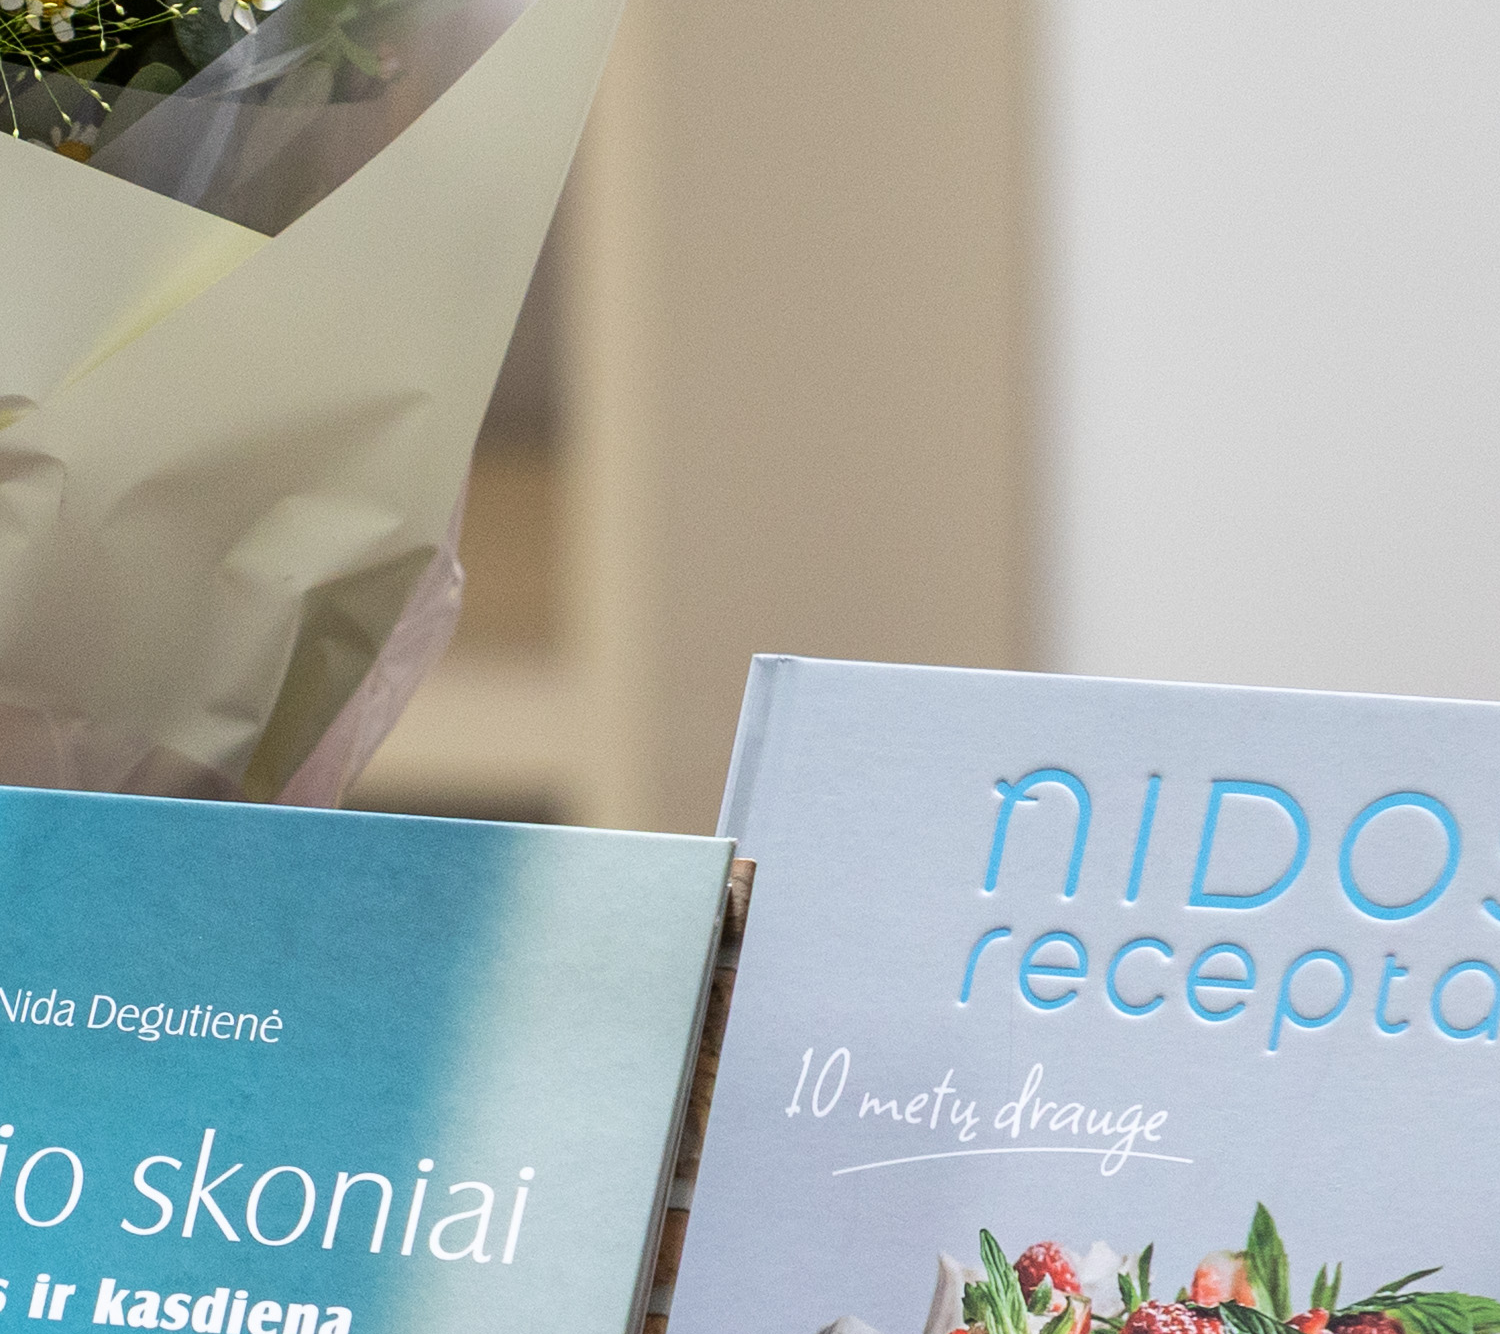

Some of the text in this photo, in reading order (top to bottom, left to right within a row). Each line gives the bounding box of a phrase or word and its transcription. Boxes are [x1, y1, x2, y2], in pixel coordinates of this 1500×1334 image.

[86, 994, 284, 1044] Degutienė
[785, 1047, 1168, 1175] 10 metų drauge
[120, 1127, 535, 1264] skoniai
[27, 1273, 77, 1321] ir
